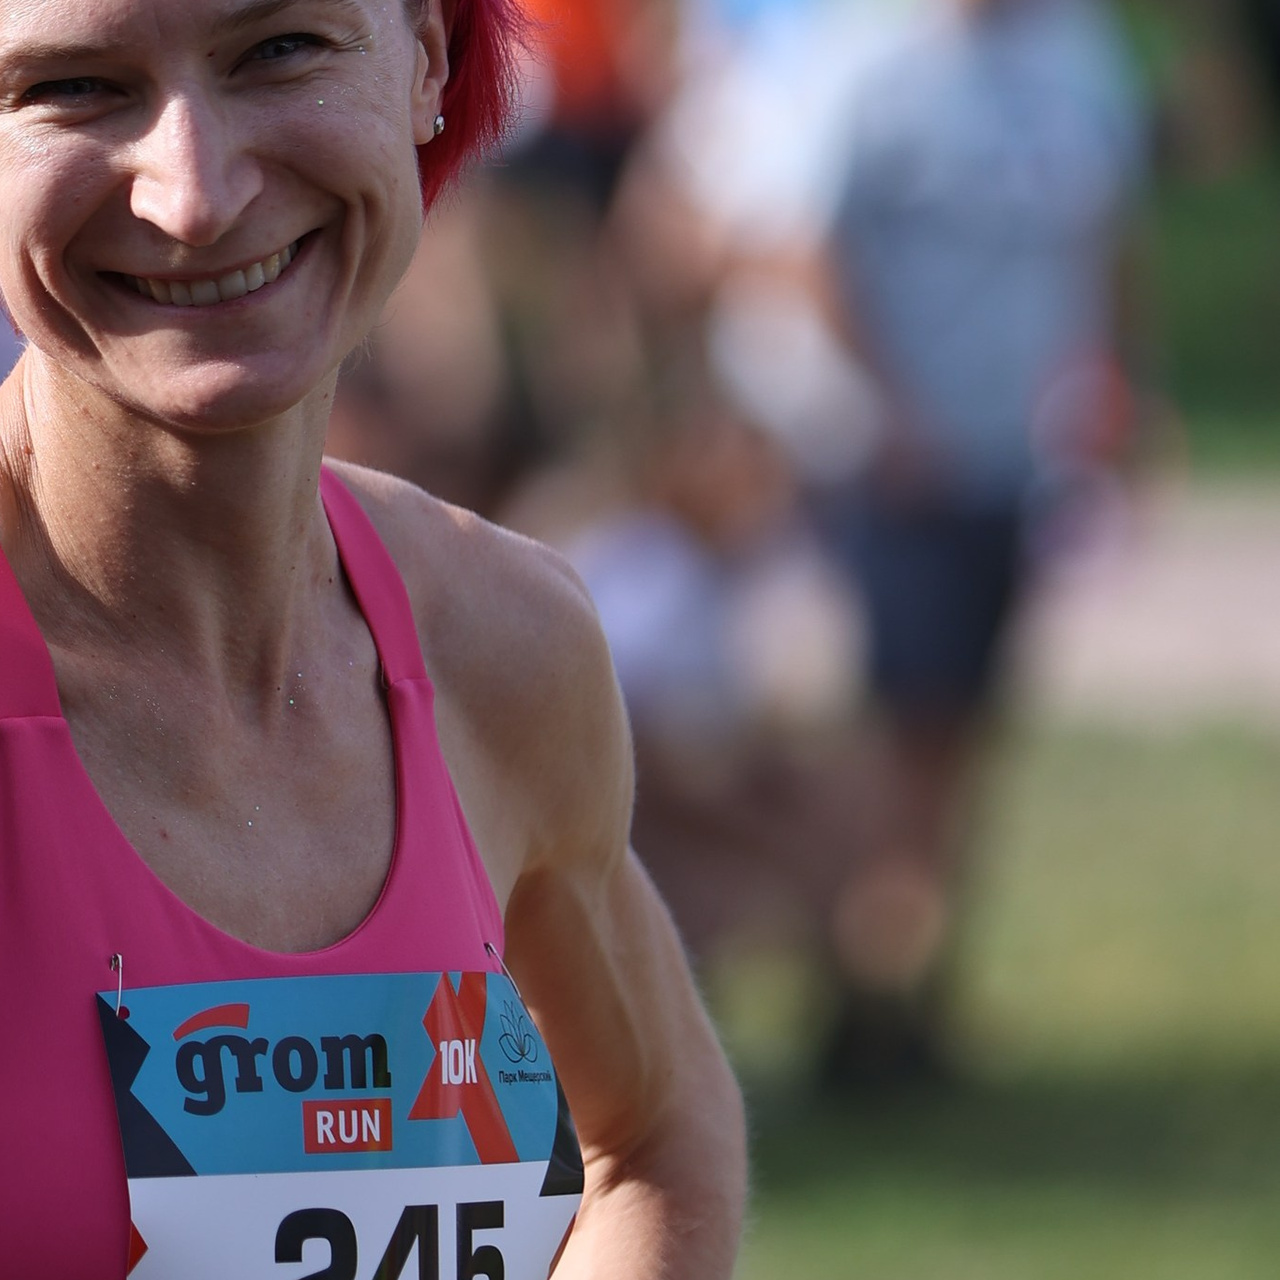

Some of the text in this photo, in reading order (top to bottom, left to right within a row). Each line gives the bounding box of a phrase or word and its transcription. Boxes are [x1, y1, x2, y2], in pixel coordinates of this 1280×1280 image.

[176, 1033, 392, 1116] grom
[440, 1039, 477, 1085] 10K
[499, 1071, 517, 1085] Парк
[317, 1109, 380, 1144] RUN
